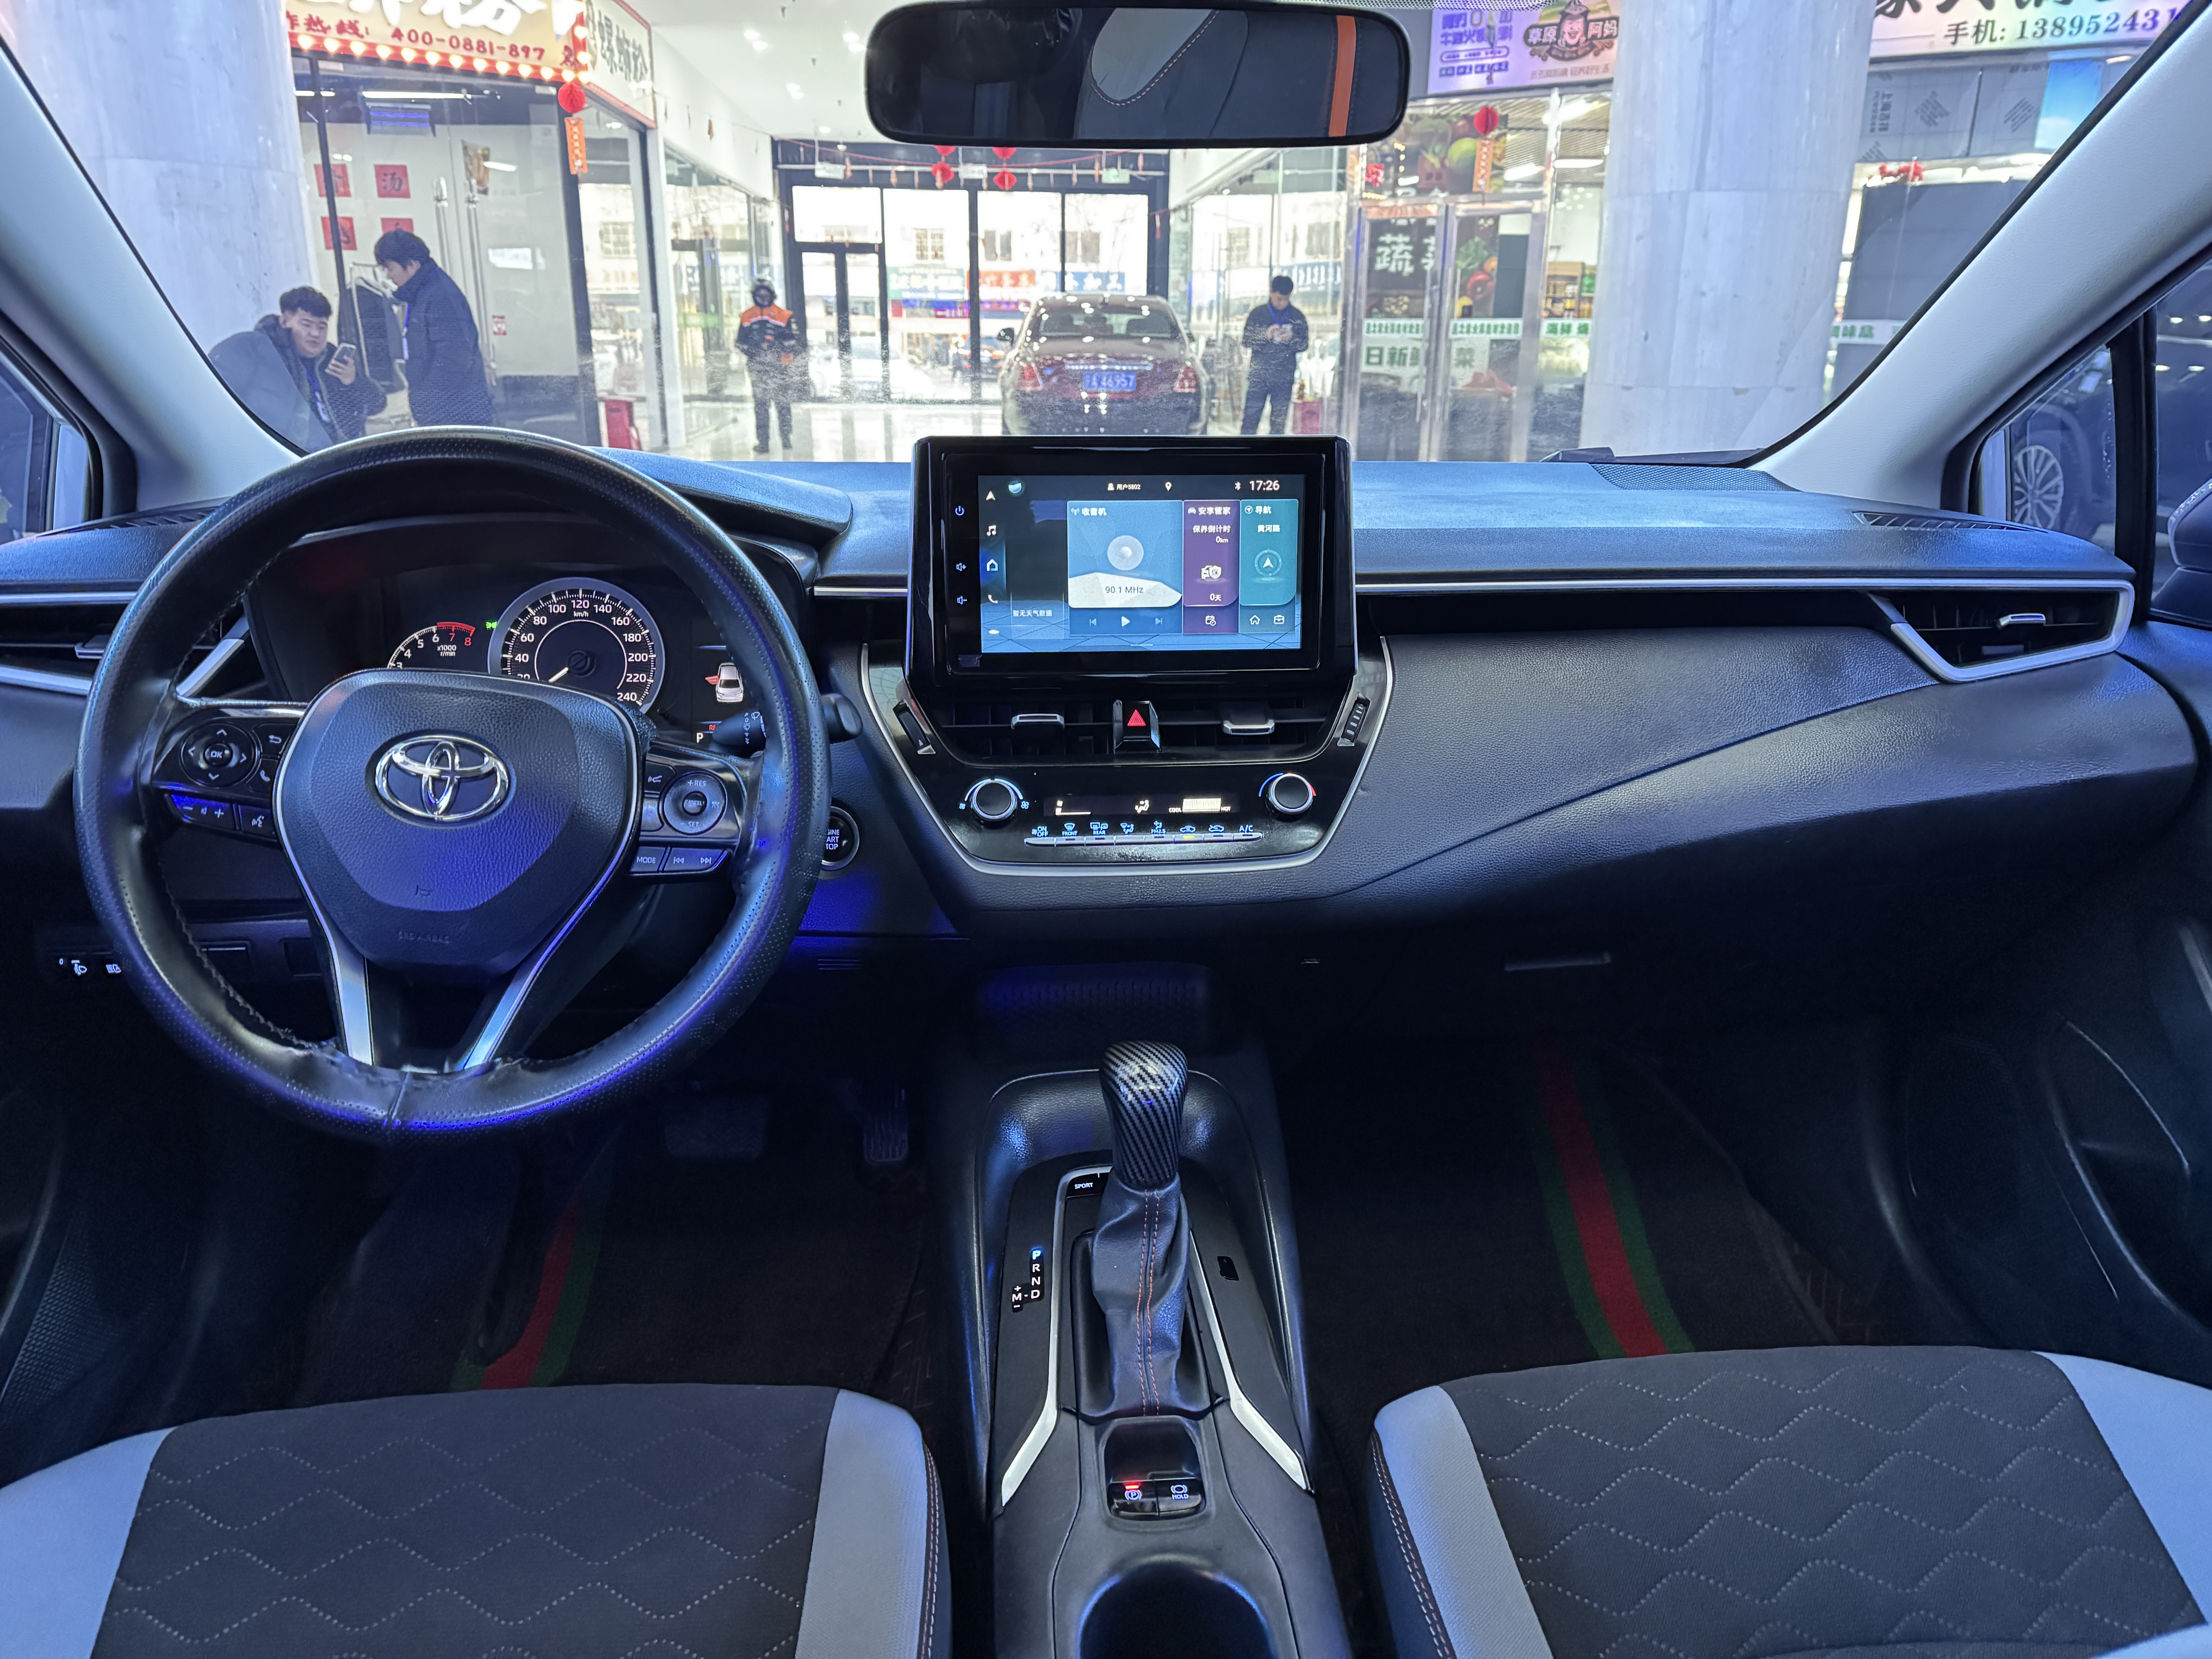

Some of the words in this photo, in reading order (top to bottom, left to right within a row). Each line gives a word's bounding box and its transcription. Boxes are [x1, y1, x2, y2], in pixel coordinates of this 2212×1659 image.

[1528, 26, 1558, 44] 草原
[1588, 20, 1617, 38] 阿妈
[391, 27, 545, 60] 400-0881-897
[382, 172, 403, 192] 汤
[1249, 480, 1280, 491] 17:26
[1082, 507, 1107, 516] 收音机
[1198, 507, 1231, 515] 安享管家
[1255, 505, 1272, 515] 导航
[1193, 525, 1231, 533] 保养倒计时
[1257, 524, 1281, 532] 黄河路
[1209, 593, 1222, 601] 0天
[548, 604, 567, 613] 100
[571, 599, 590, 609] 120
[593, 604, 612, 613] 140
[533, 616, 547, 625] 80
[611, 617, 630, 626] 160
[432, 634, 440, 642] 6
[449, 633, 455, 642] 7
[464, 637, 472, 646] 8
[520, 633, 534, 642] 60
[623, 633, 642, 642] 180
[417, 639, 424, 648] 5
[404, 649, 412, 658] 4
[514, 653, 529, 663] 40
[628, 653, 648, 662] 200
[626, 673, 646, 682] 220
[617, 692, 637, 701] 240
[697, 732, 704, 743] P
[210, 750, 222, 759] OK
[1239, 824, 1253, 833] A/C
[1032, 1250, 1041, 1260] P
[1032, 1263, 1041, 1273] R
[1031, 1276, 1041, 1286] N
[1012, 1293, 1022, 1302] M
[1031, 1290, 1040, 1299] D
